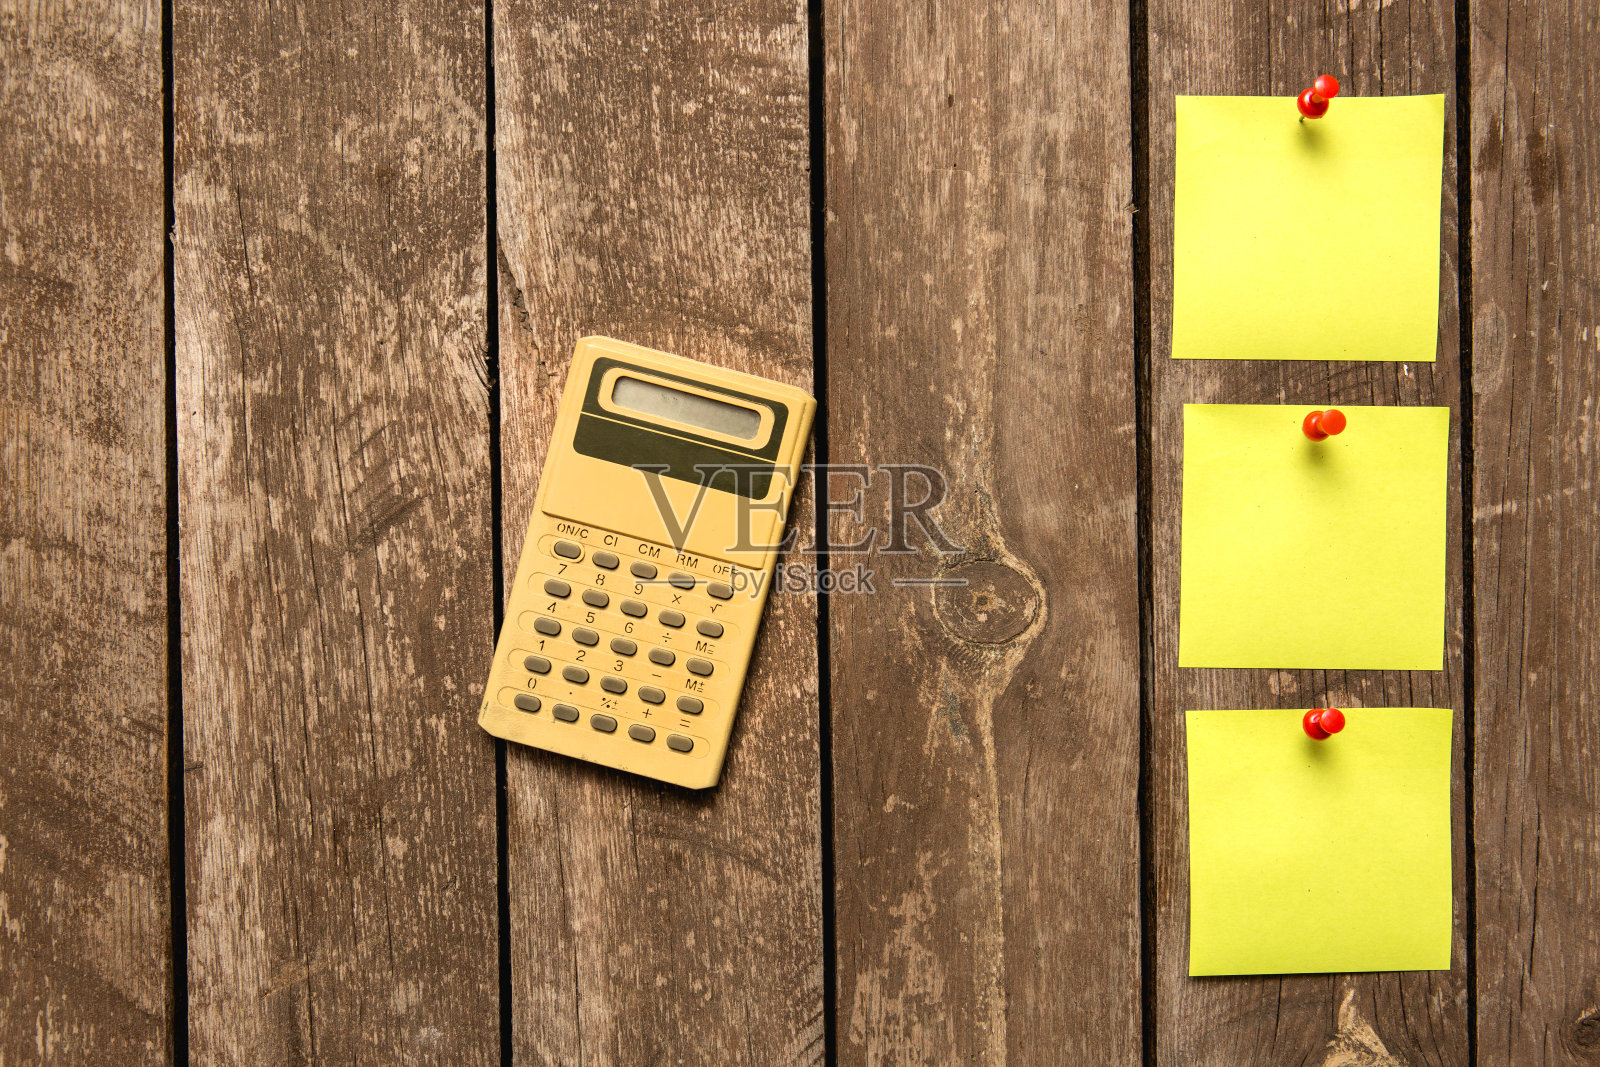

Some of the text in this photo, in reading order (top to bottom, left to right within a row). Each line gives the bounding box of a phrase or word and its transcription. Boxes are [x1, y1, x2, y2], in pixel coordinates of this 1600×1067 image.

[556, 522, 590, 540] ON/C
[638, 543, 661, 559] CM
[675, 553, 699, 569] RM
[557, 563, 568, 575] 7
[595, 573, 606, 586] 8
[634, 583, 644, 595] 9
[547, 601, 557, 613] 4
[585, 611, 596, 624] 5
[624, 621, 634, 634] 6
[538, 639, 546, 652] 1
[576, 650, 587, 662] 2
[613, 660, 624, 672] 3
[527, 677, 537, 689] 0
